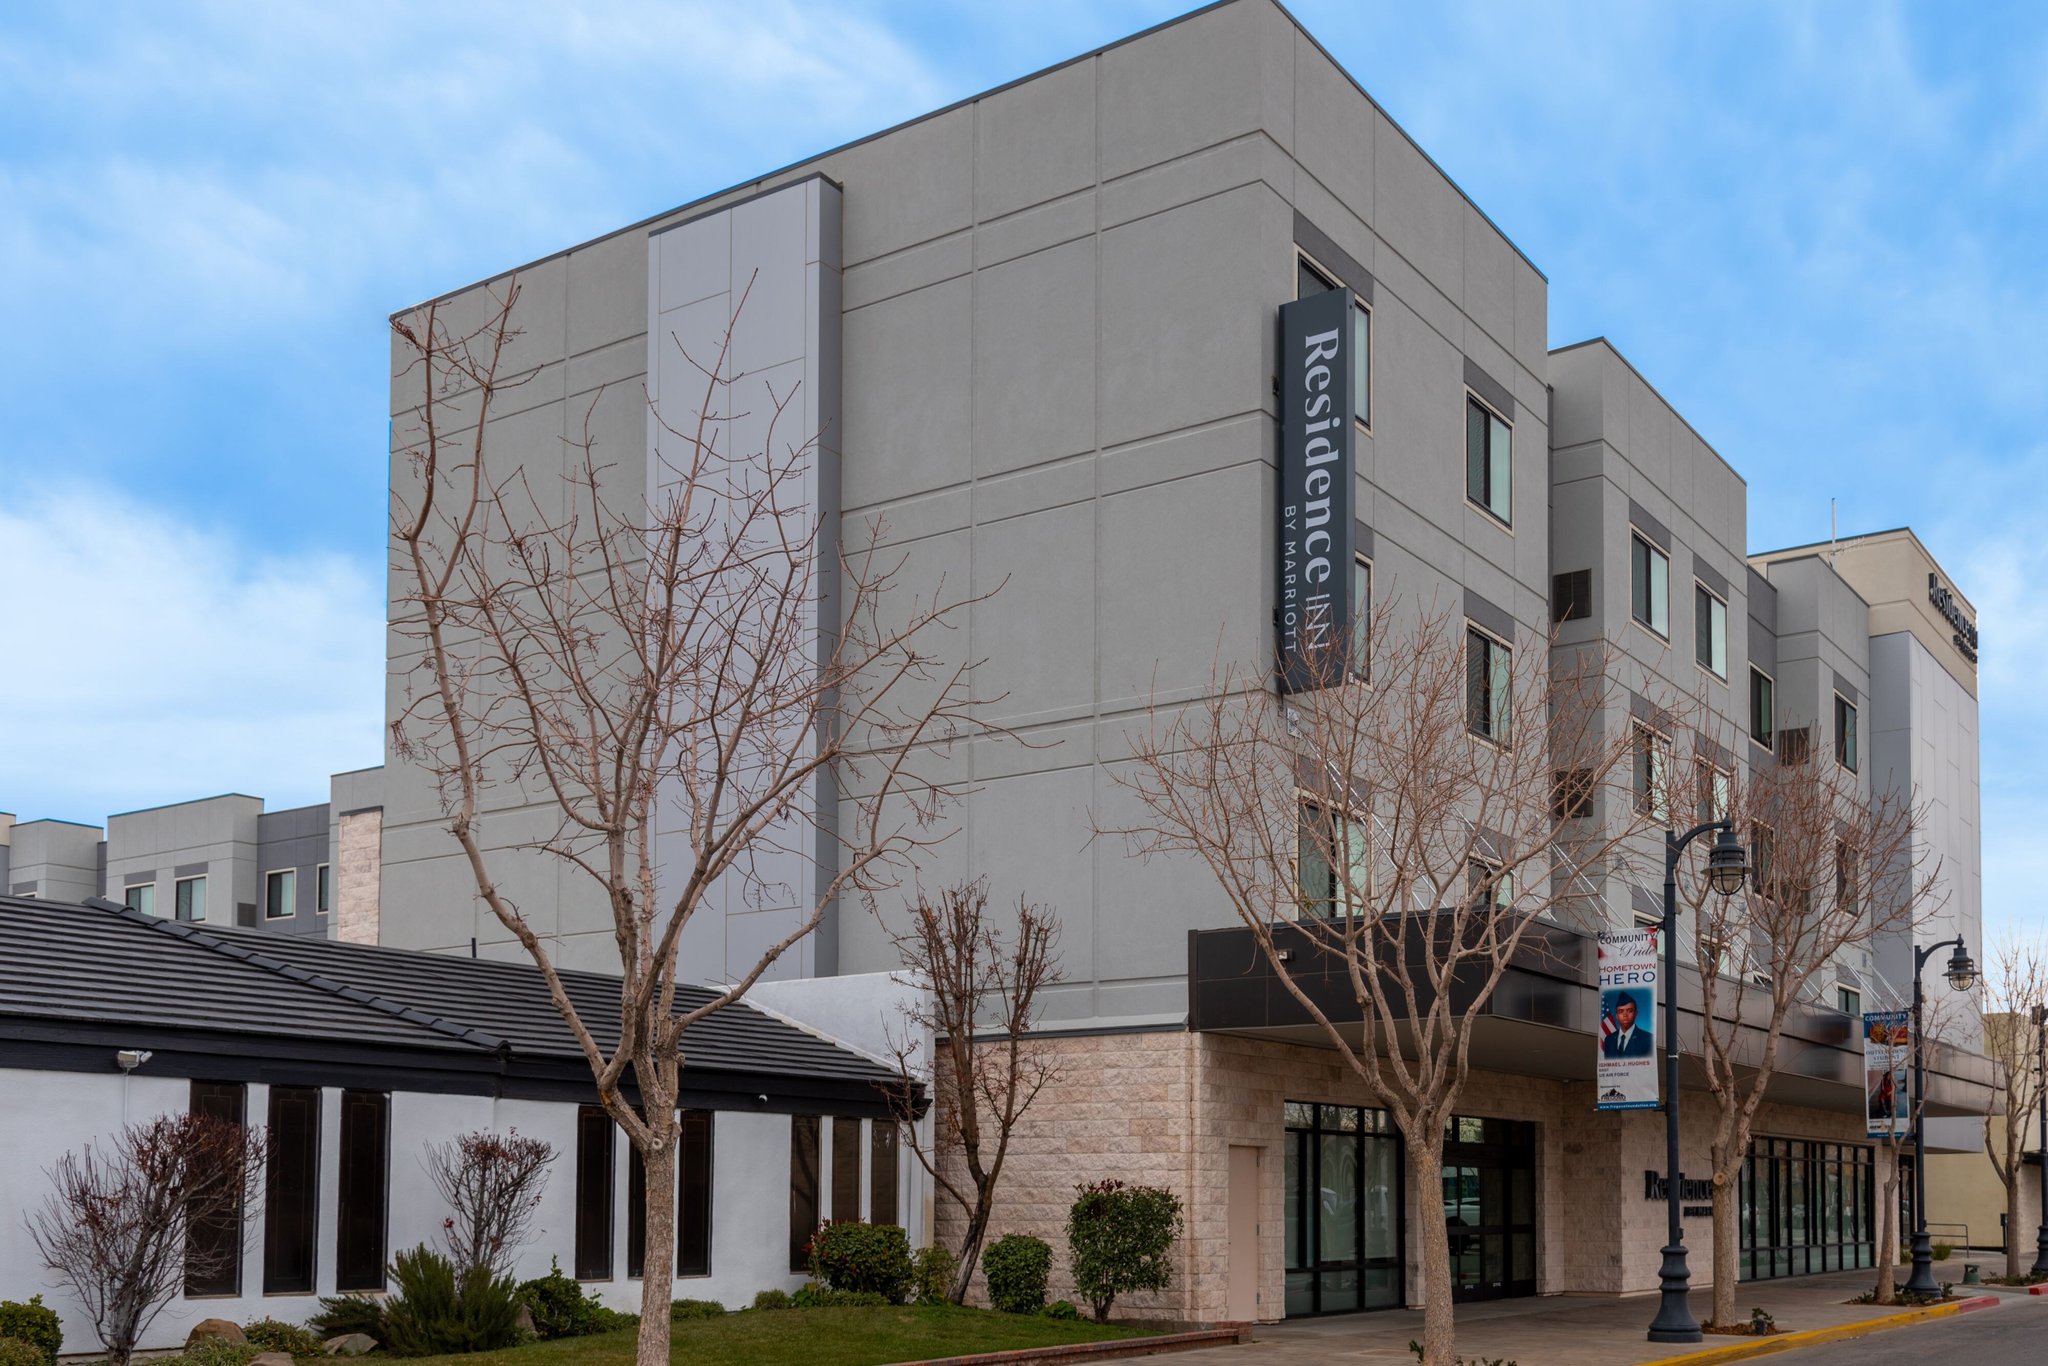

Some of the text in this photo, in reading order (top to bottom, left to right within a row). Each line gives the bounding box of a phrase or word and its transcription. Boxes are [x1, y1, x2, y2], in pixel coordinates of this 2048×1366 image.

[1305, 327, 1341, 651] Residence INN
[1284, 505, 1297, 652] BY MARRIOTT
[1600, 933, 1656, 945] COMMUNITY
[1619, 942, 1657, 957] Pride
[1599, 963, 1657, 973] HOMETOWN
[1599, 971, 1656, 985] HERO
